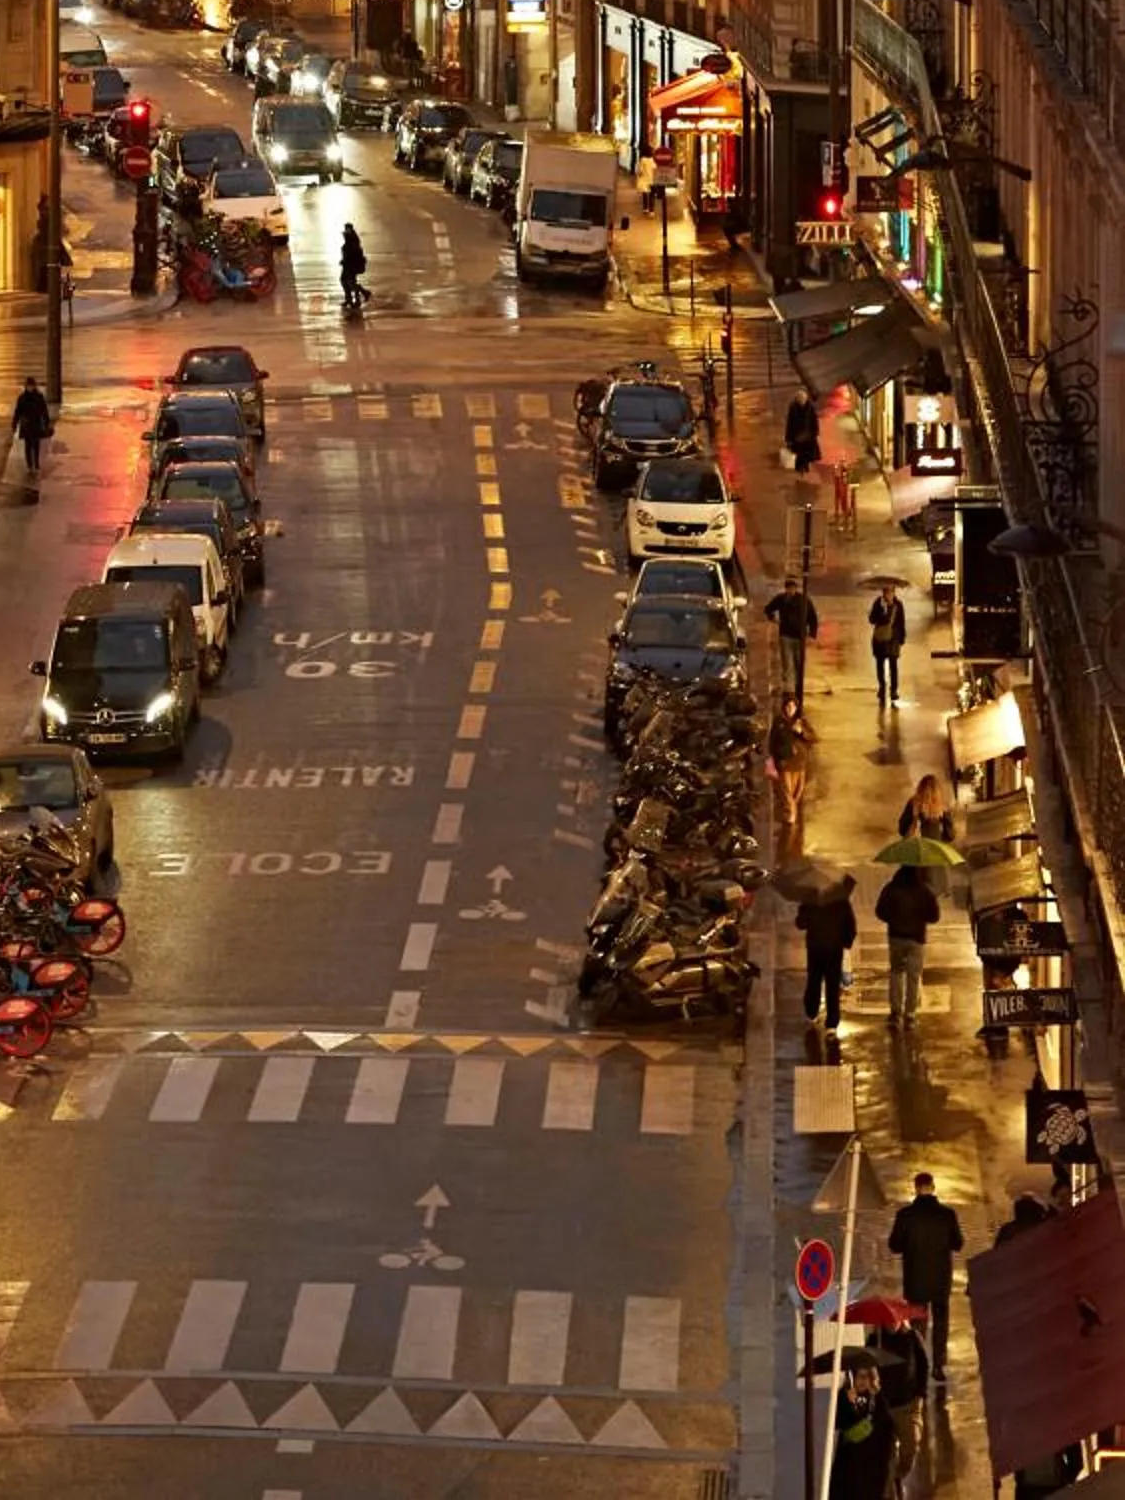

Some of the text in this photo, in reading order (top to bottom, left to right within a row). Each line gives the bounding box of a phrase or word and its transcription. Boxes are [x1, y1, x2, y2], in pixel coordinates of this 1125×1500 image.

[273, 631, 435, 650] km/h
[284, 660, 398, 679] 30
[192, 765, 416, 789] RALENTIR
